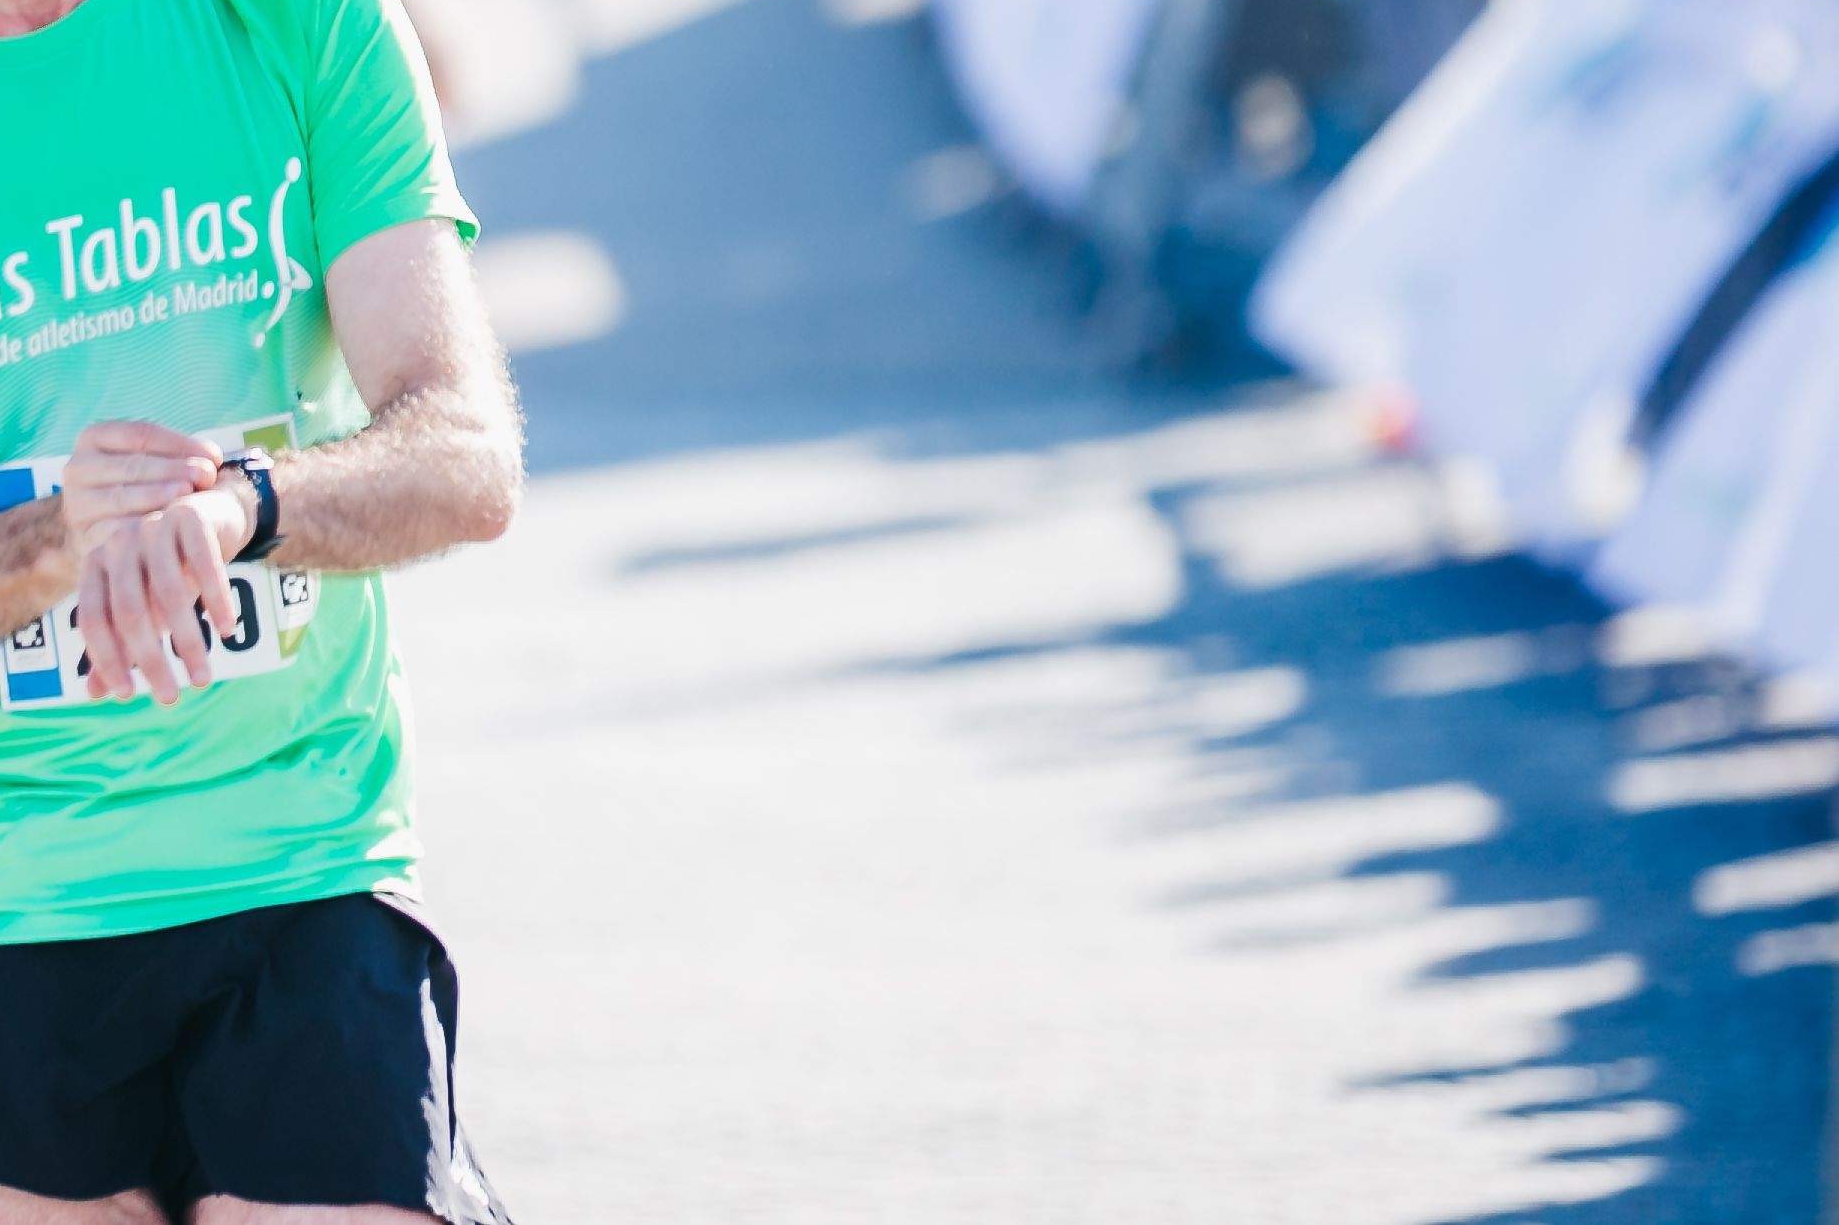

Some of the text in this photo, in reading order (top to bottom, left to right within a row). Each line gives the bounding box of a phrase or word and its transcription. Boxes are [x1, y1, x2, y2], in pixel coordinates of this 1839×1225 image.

[45, 187, 259, 299] Tablas
[27, 304, 135, 357] atletismo
[138, 292, 168, 325] de
[172, 268, 259, 315] Madrid
